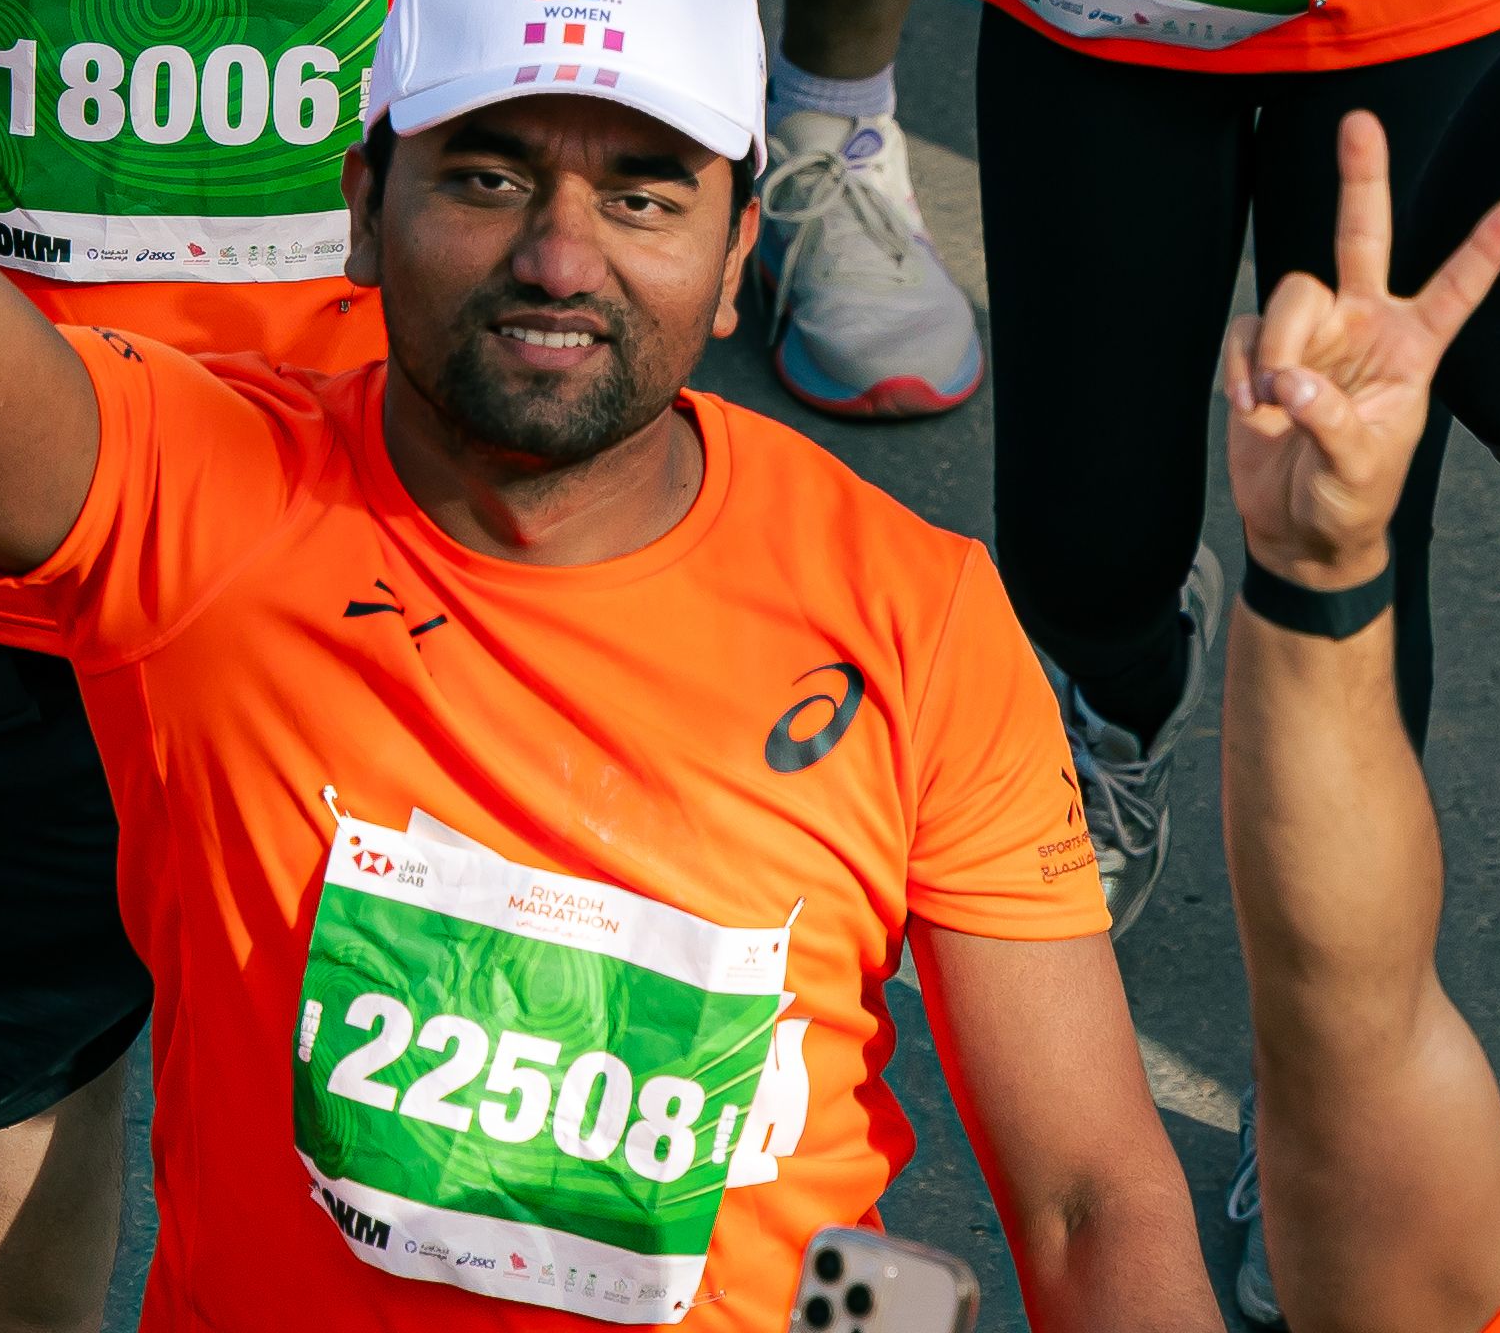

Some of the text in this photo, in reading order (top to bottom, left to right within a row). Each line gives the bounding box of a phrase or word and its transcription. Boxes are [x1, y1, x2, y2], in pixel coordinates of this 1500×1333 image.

[544, 6, 612, 23] WOMEN
[149, 250, 175, 262] asics
[397, 872, 426, 889] SAB
[508, 895, 621, 935] MARATHON
[530, 885, 605, 915] RIYADH
[326, 992, 706, 1183] 22508
[310, 1186, 392, 1252] 0KM
